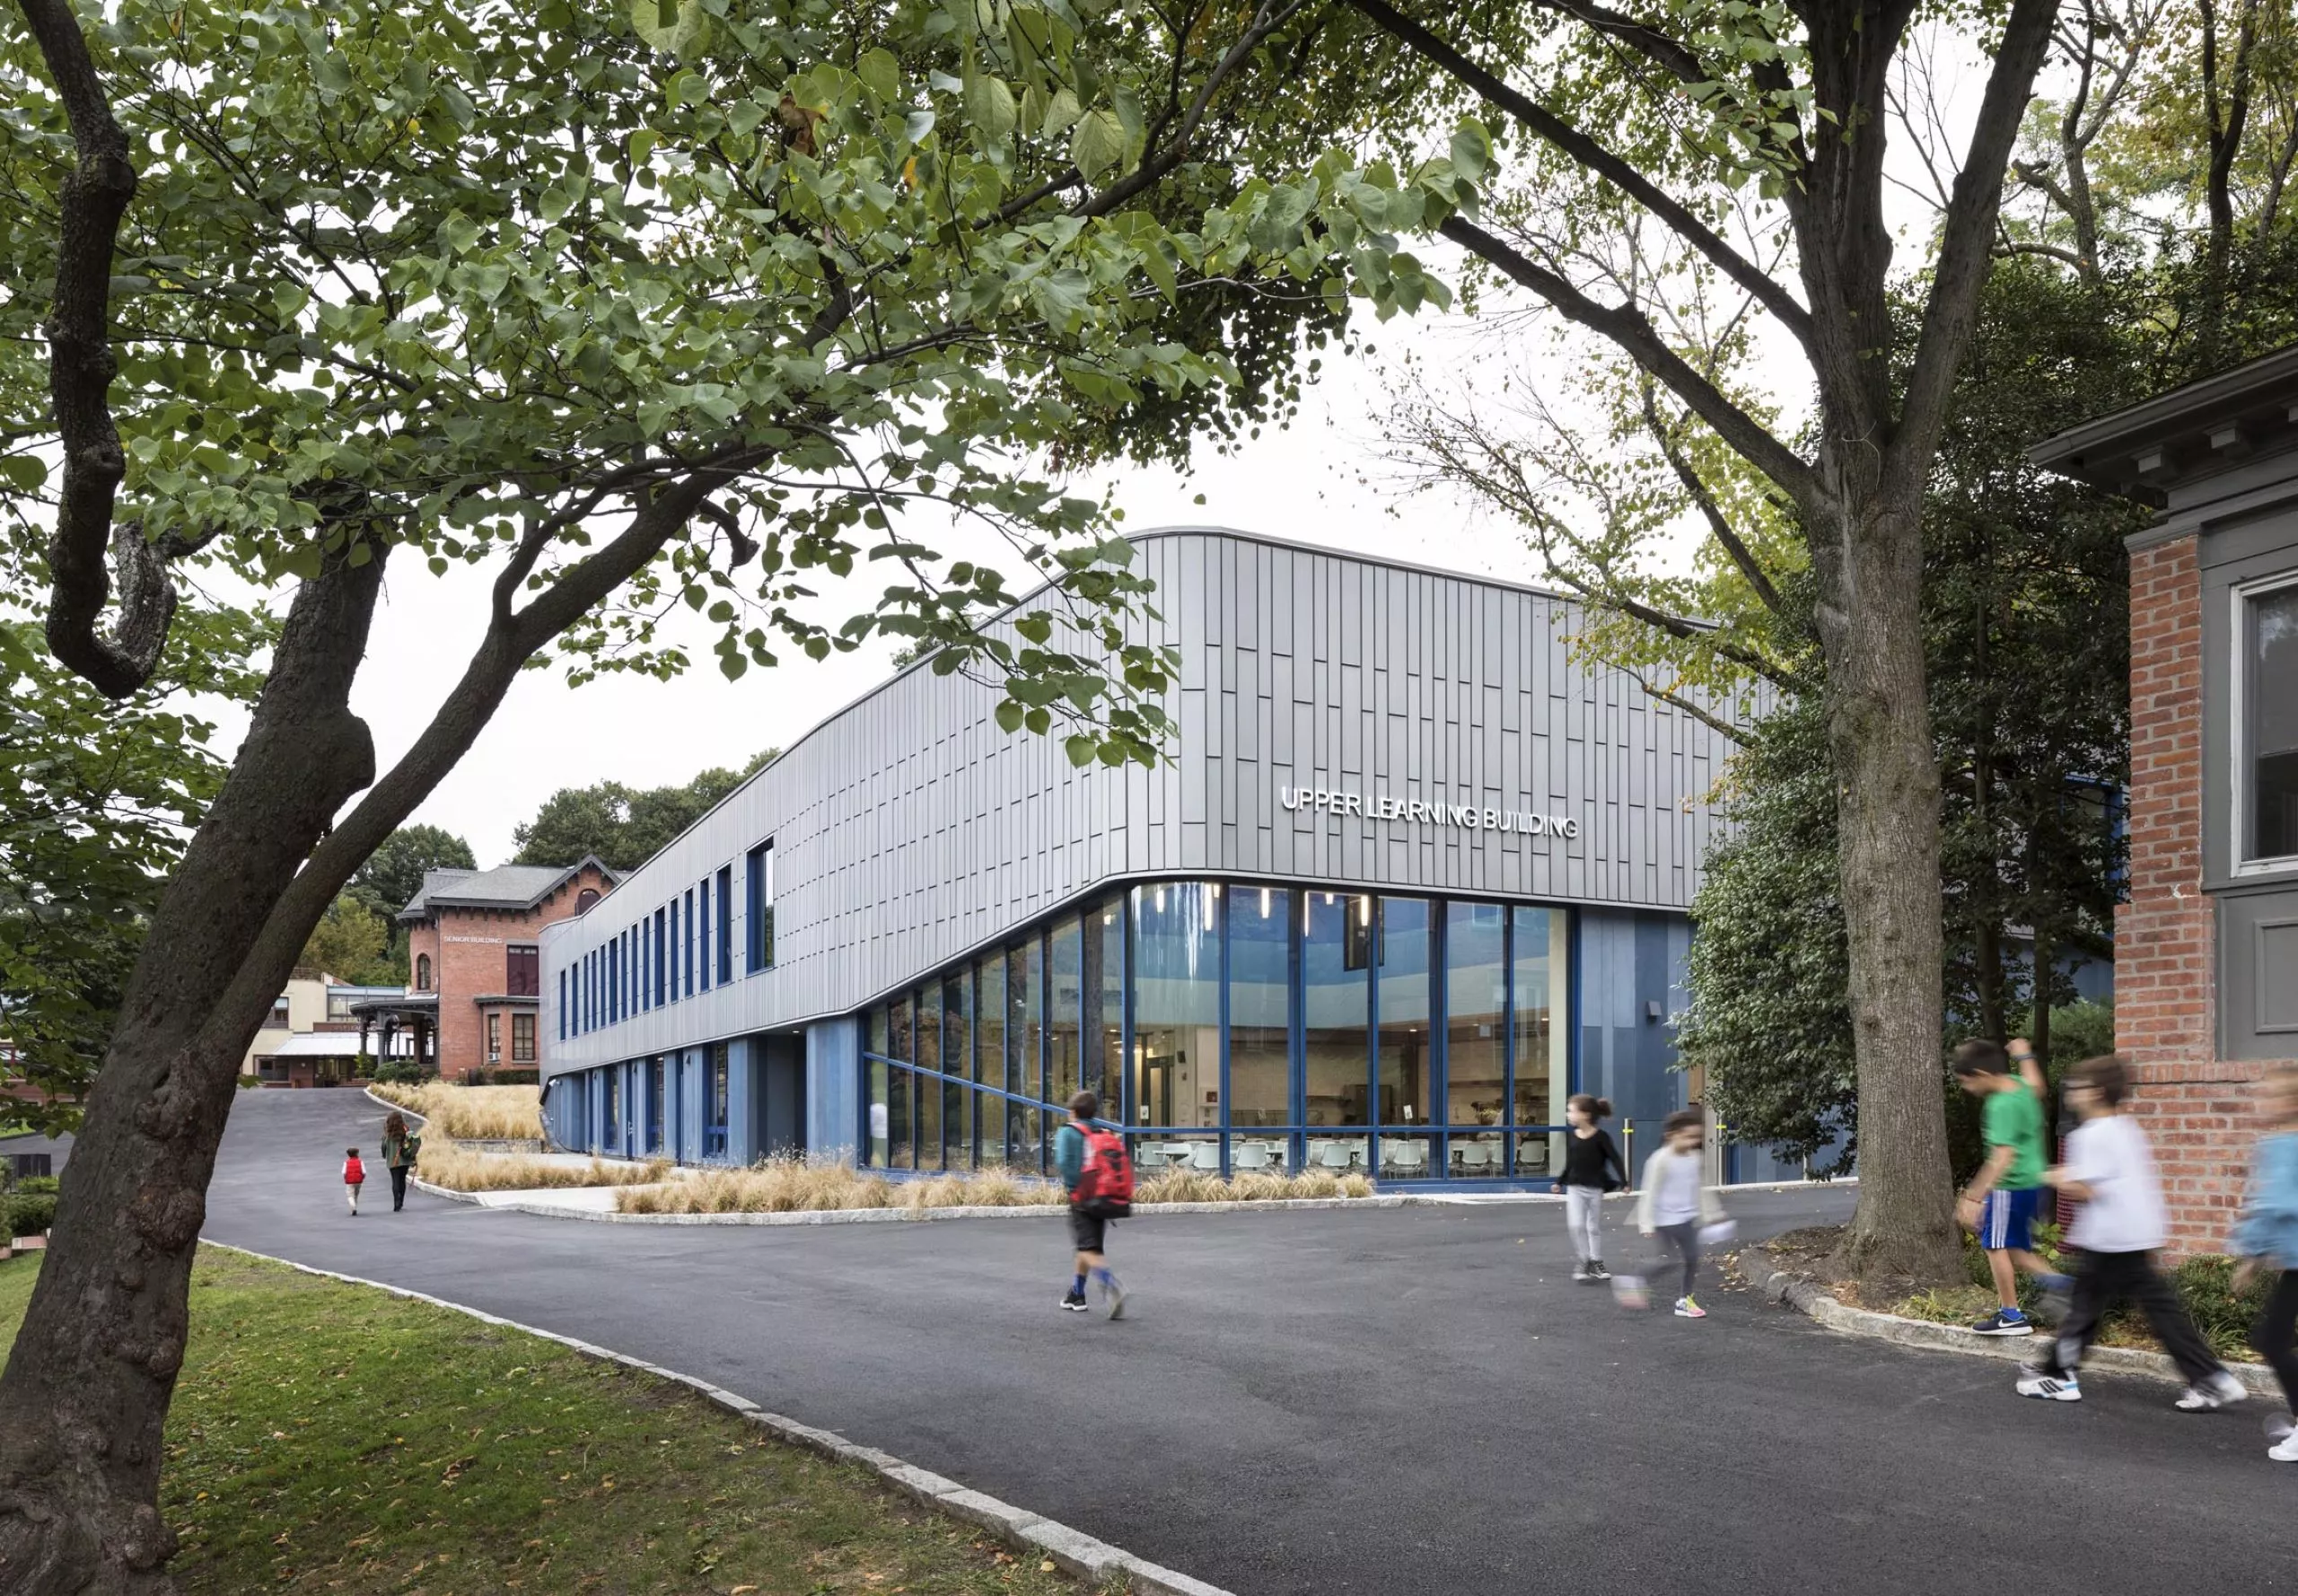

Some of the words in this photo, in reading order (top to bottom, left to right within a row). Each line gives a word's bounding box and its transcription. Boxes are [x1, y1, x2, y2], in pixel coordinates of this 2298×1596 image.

[1282, 785, 1362, 816] UPPER
[1367, 796, 1478, 828] LEARNING
[1484, 808, 1577, 837] BUILDING
